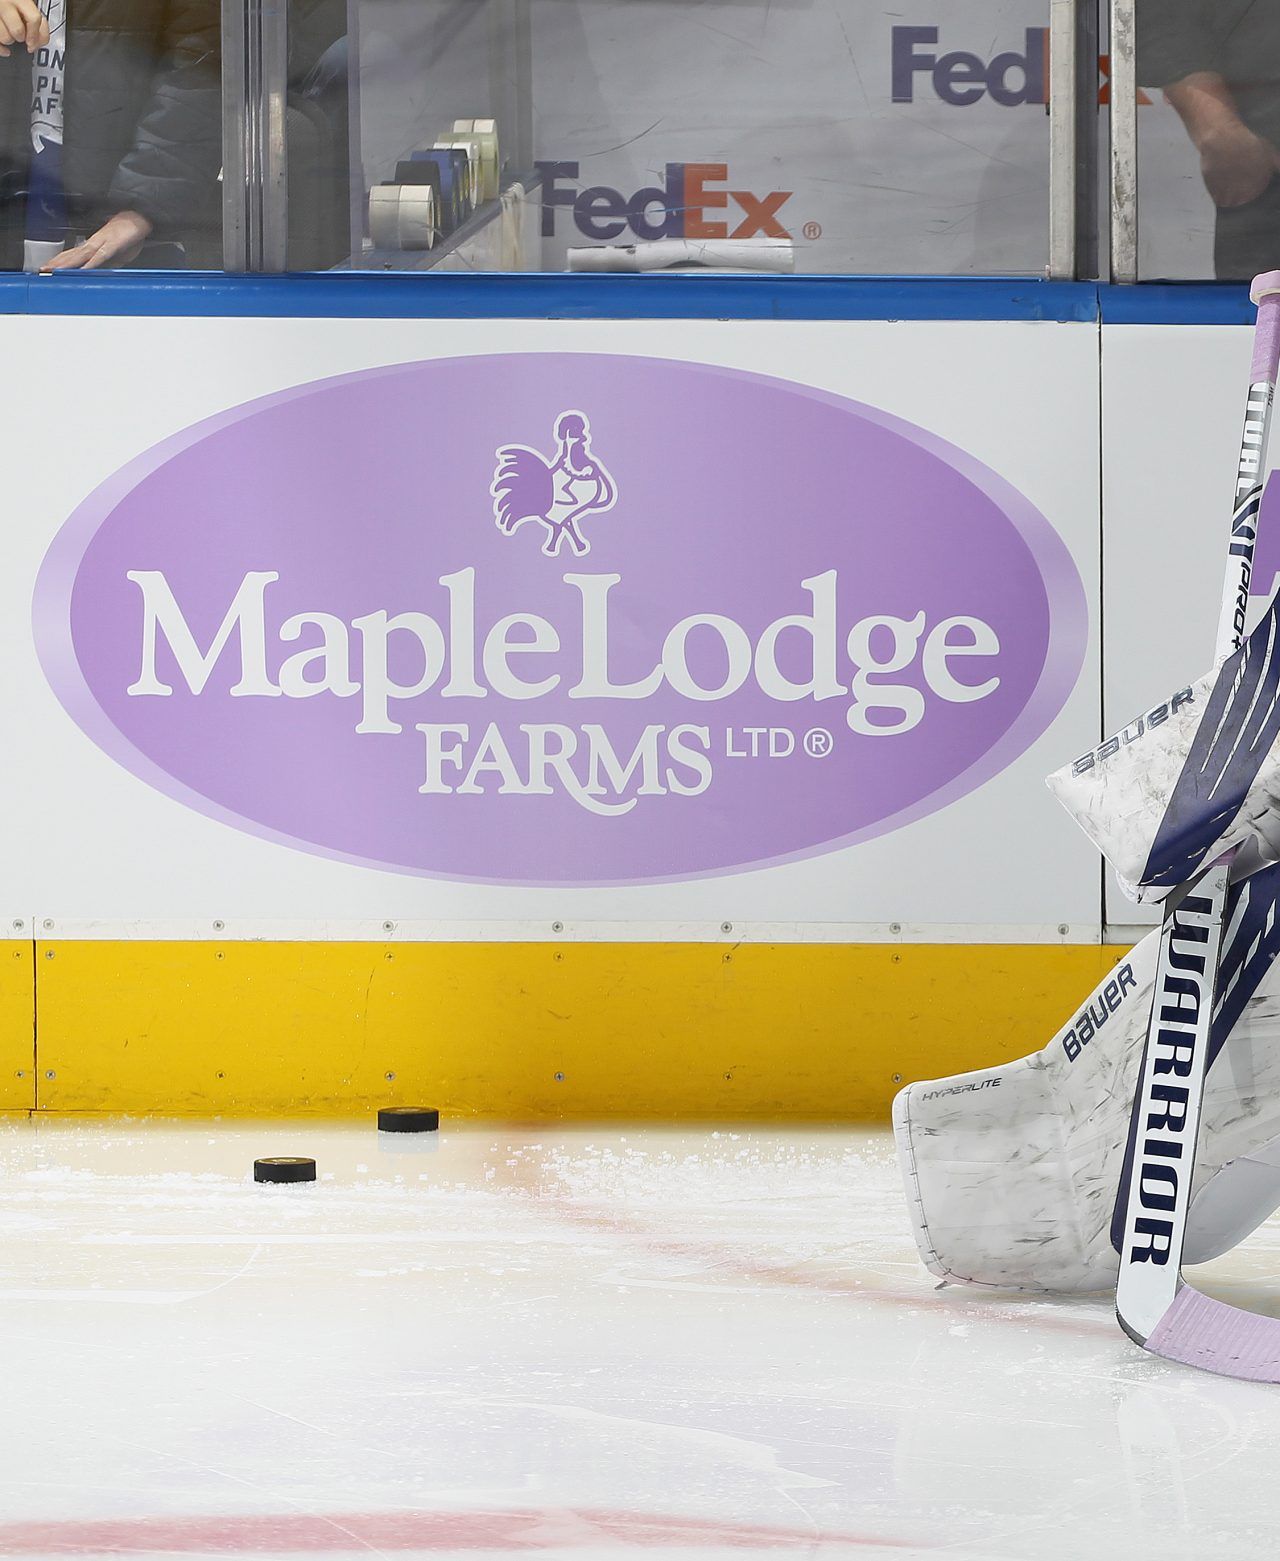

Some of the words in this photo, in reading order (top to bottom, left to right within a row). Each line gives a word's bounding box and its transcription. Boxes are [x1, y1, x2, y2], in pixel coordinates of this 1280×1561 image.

[534, 161, 794, 240] FedEx
[417, 723, 713, 815] FARMS
[922, 1077, 1003, 1102] HYPERLITE
[1130, 895, 1214, 1267] WARRIOR
